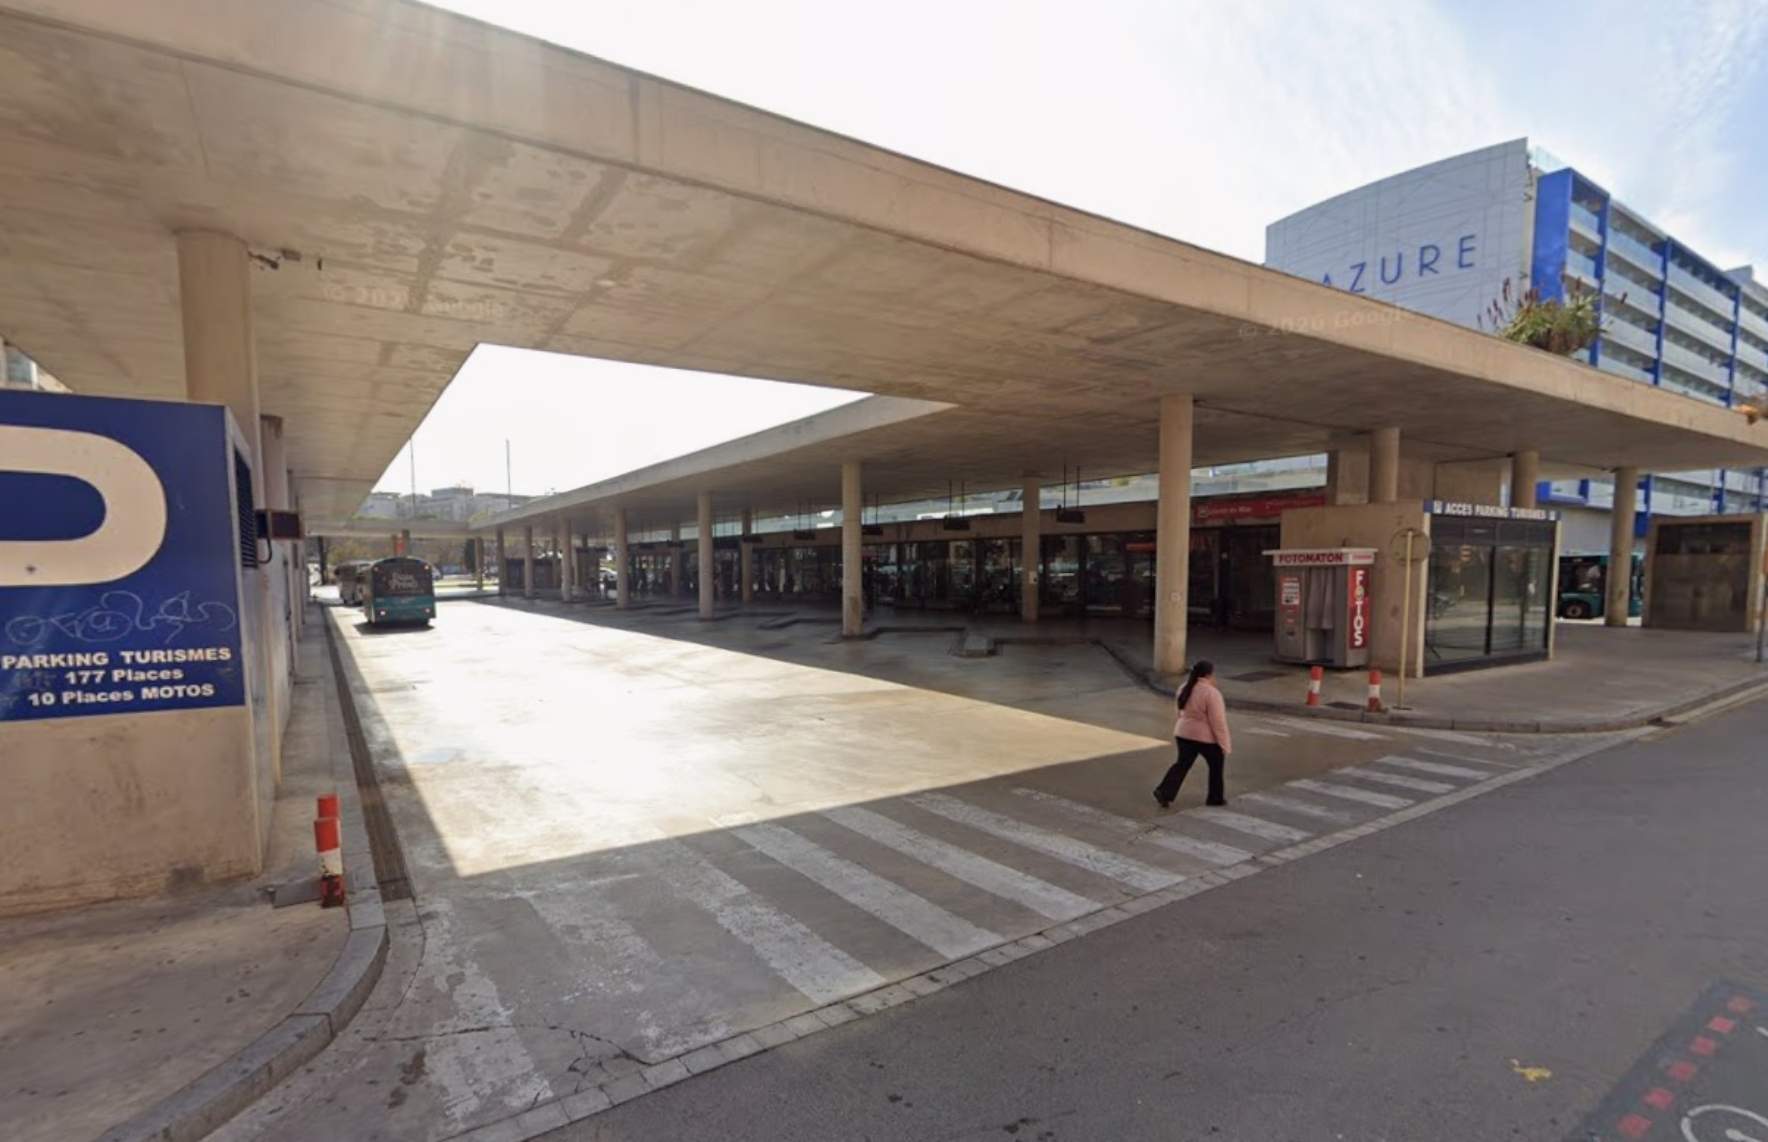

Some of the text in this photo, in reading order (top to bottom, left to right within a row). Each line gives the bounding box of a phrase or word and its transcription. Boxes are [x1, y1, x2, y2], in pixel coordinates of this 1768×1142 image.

[1279, 552, 1344, 563] FOTOMATON
[1353, 569, 1364, 647] FOTOS
[2, 647, 232, 670] PARKING TURISMES
[65, 669, 184, 685] 177 Places
[29, 683, 216, 707] 10 Places MOTOS
